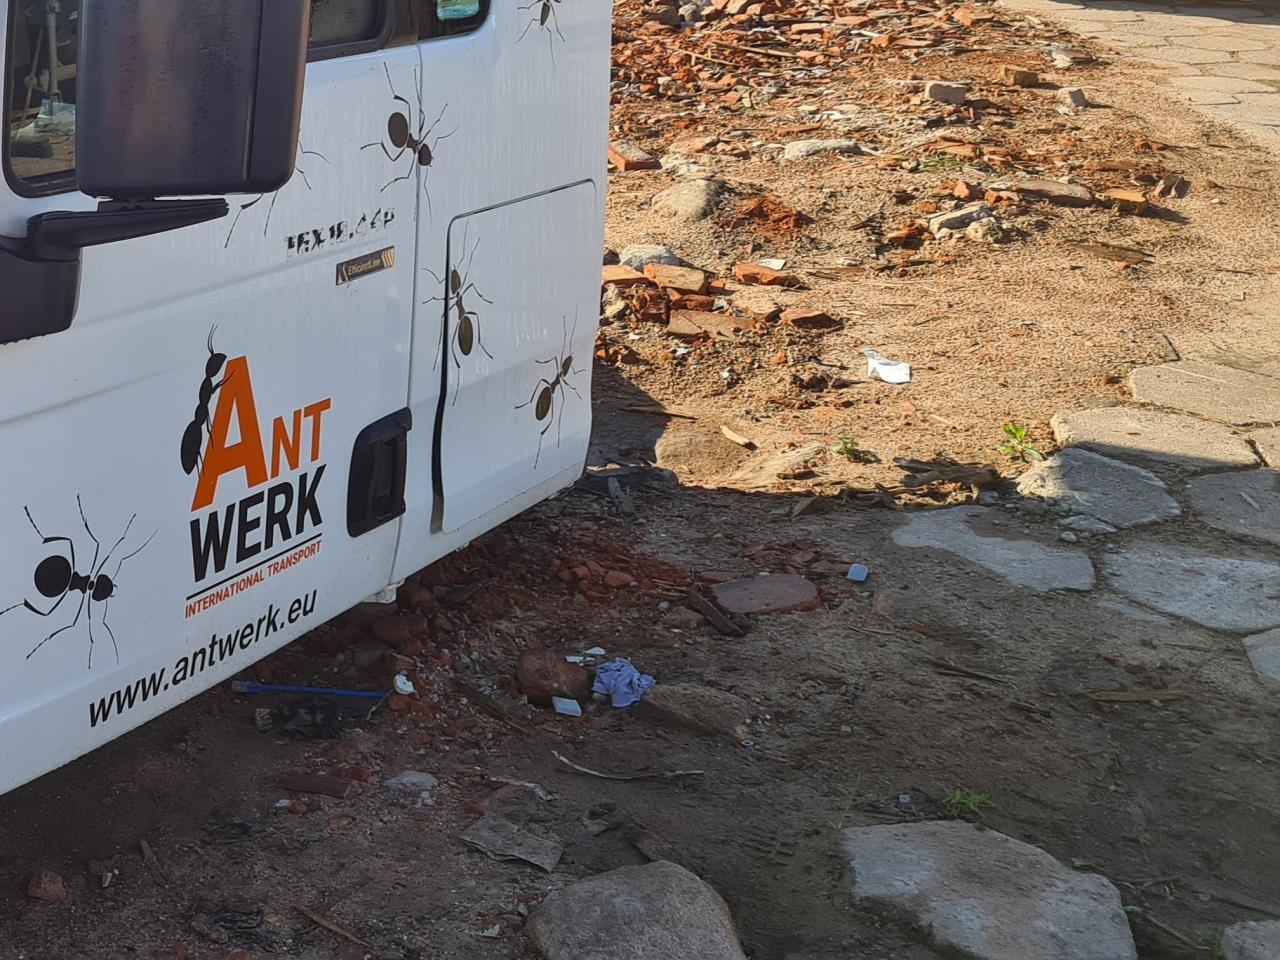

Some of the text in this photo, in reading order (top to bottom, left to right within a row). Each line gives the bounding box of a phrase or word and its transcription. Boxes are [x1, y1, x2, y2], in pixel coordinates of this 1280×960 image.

[184, 539, 322, 620] INTERNATIONAL TRANSPORT
[190, 463, 327, 583] WERK
[88, 589, 318, 728] www.antwerk.eu
